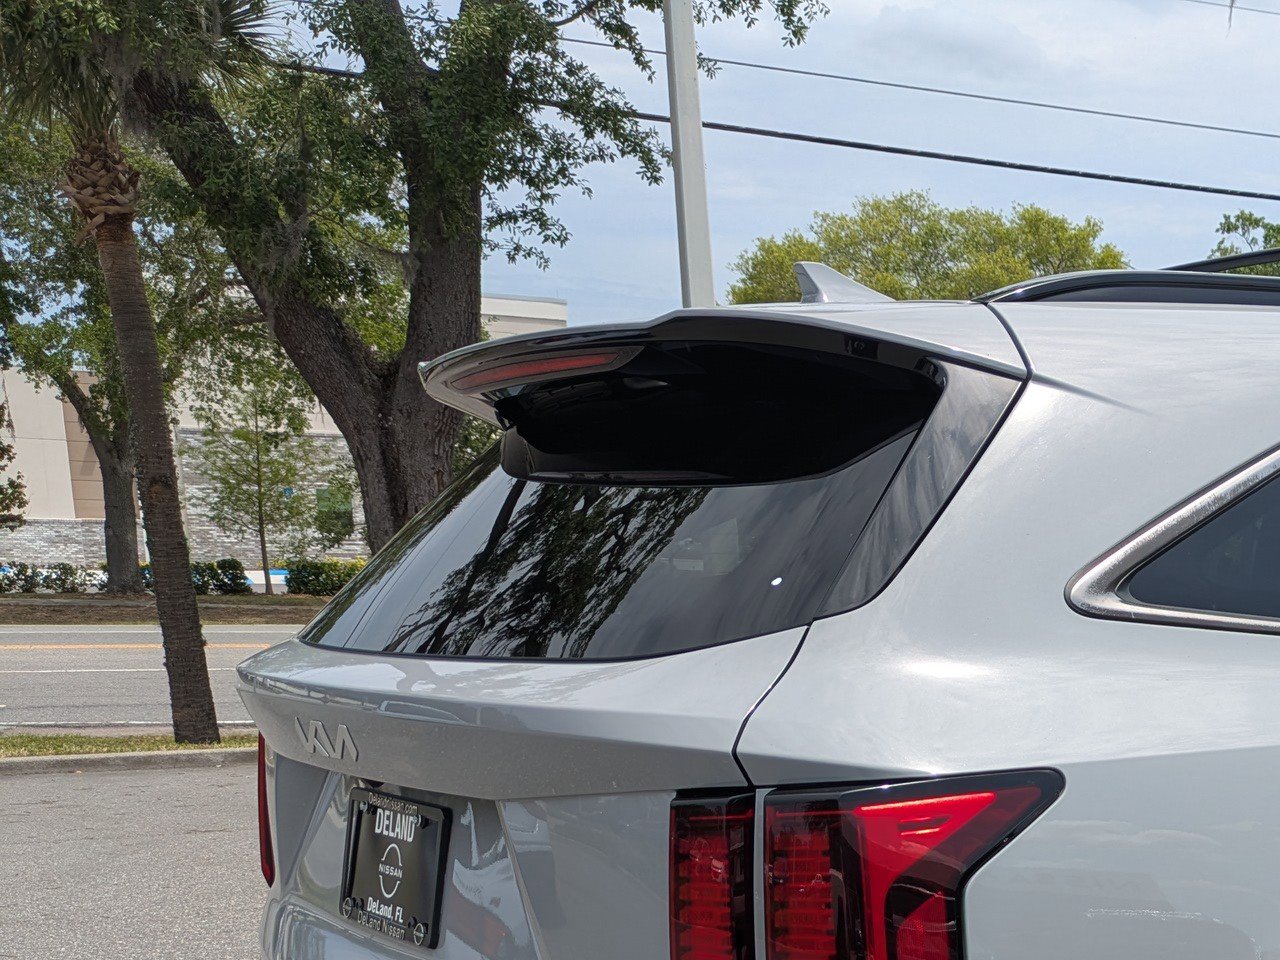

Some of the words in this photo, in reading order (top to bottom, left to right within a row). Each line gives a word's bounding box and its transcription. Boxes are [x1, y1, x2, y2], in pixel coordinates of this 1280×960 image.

[295, 717, 358, 762] KIA
[374, 808, 416, 843] DELAND
[379, 863, 403, 878] NISSAN
[367, 896, 393, 920] DeLand,
[395, 908, 404, 923] FL
[382, 919, 405, 940] Nissan
